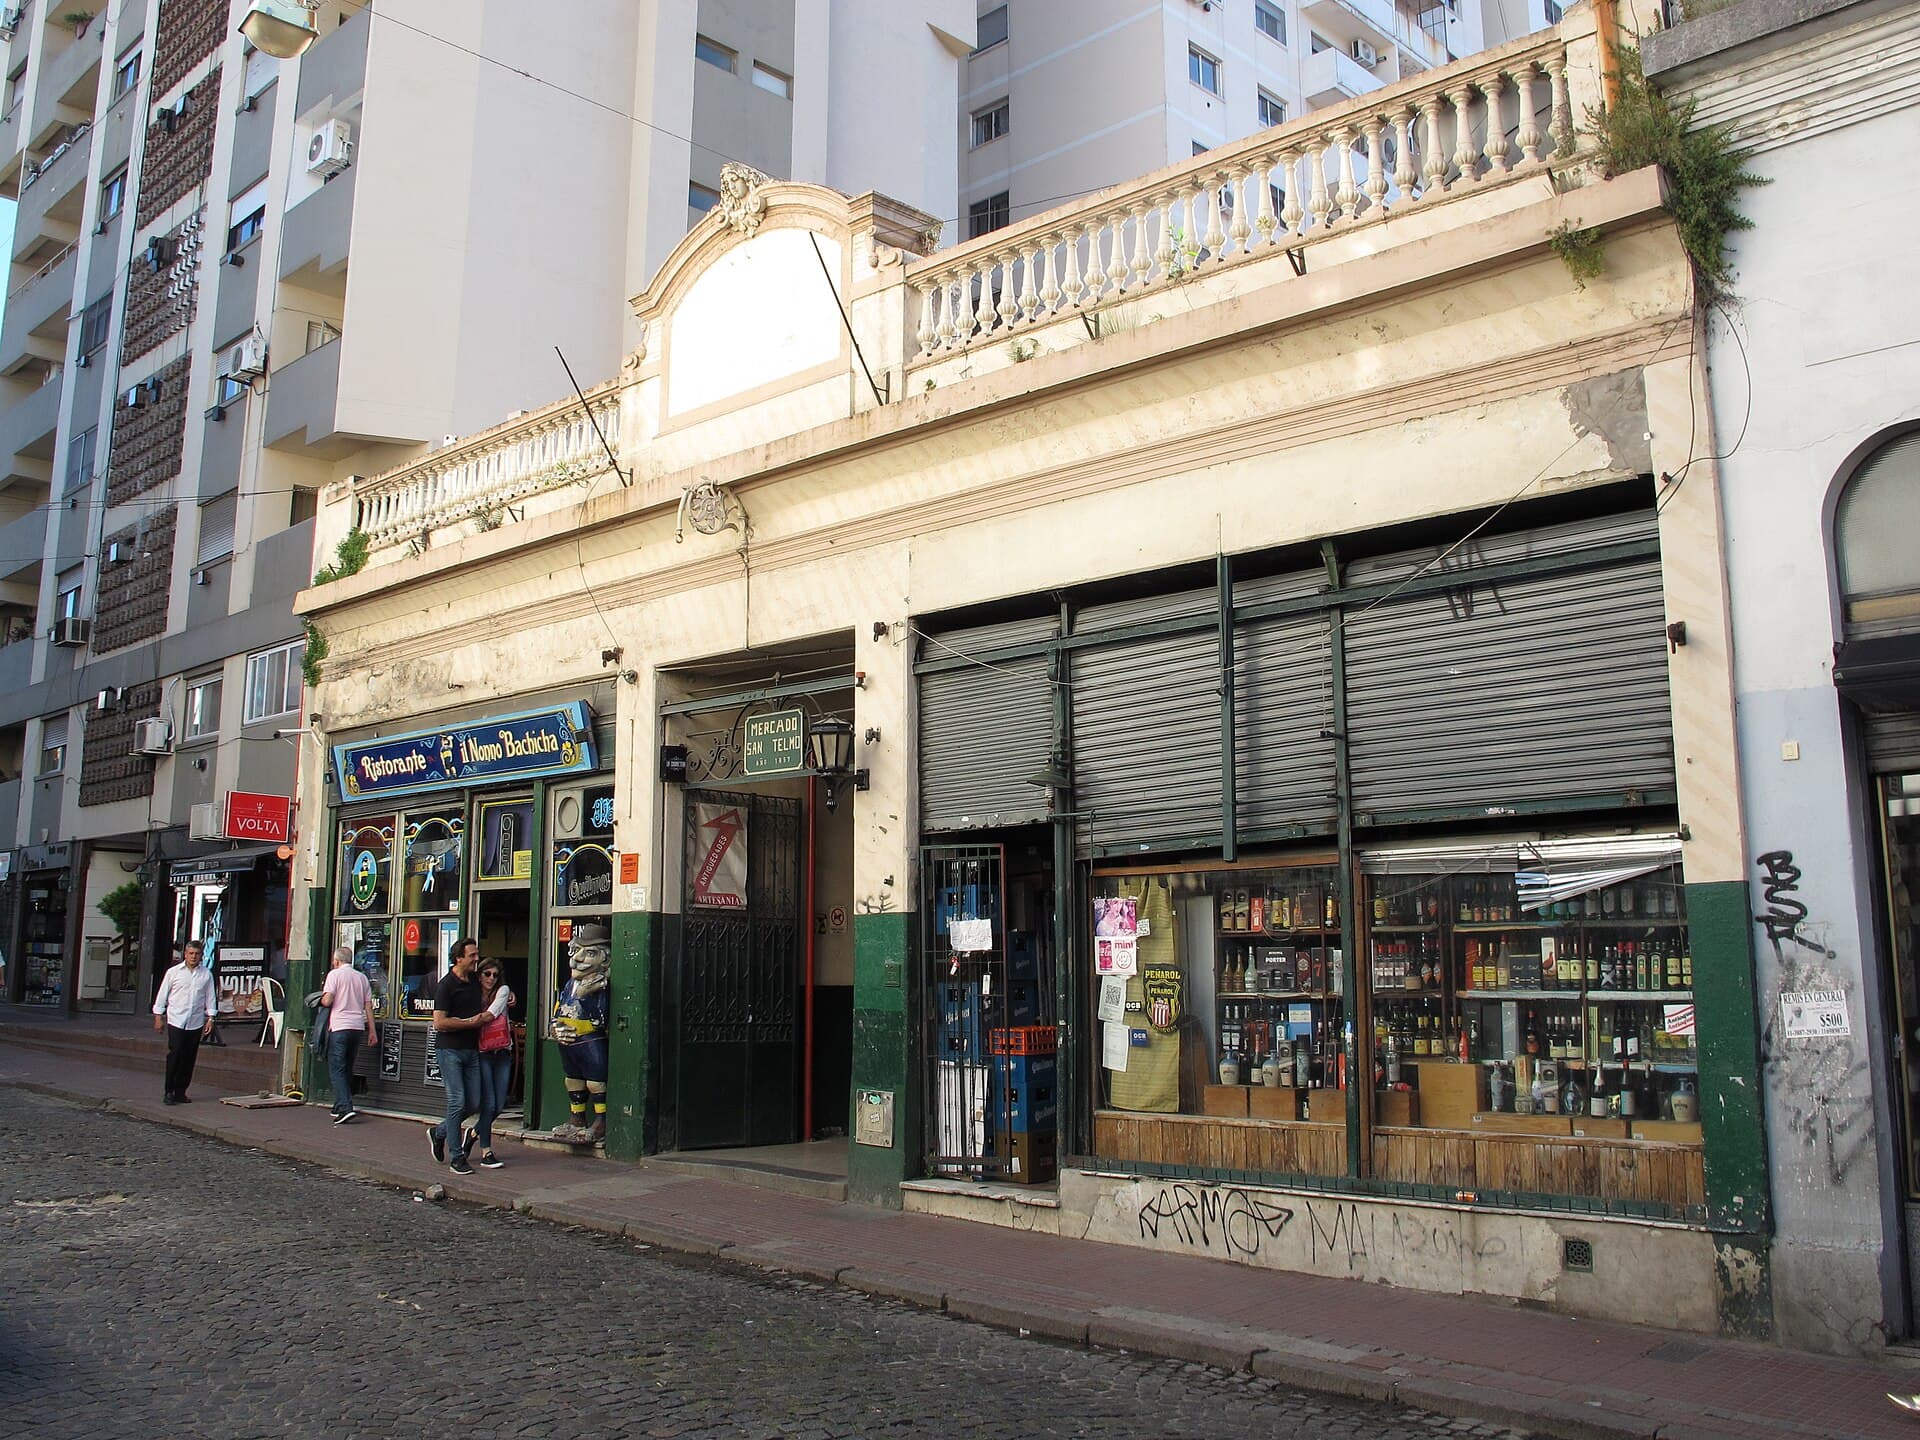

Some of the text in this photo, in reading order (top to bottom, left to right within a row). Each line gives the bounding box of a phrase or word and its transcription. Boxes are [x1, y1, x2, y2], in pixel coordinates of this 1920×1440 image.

[750, 717, 798, 737] MERCADO
[361, 749, 427, 781] Ristorante
[469, 737, 502, 762] Nonno
[498, 728, 559, 758] Bachicha
[746, 735, 801, 756] SAN TELMO
[236, 817, 280, 835] VOLTA
[501, 816, 512, 876] OPEN
[700, 835, 727, 886] ANTIGUEDADES
[1115, 941, 1134, 949] mini
[1145, 969, 1181, 979] PEÑAROL
[1814, 990, 1844, 1002] GENERAL
[1819, 1013, 1843, 1027] $500
